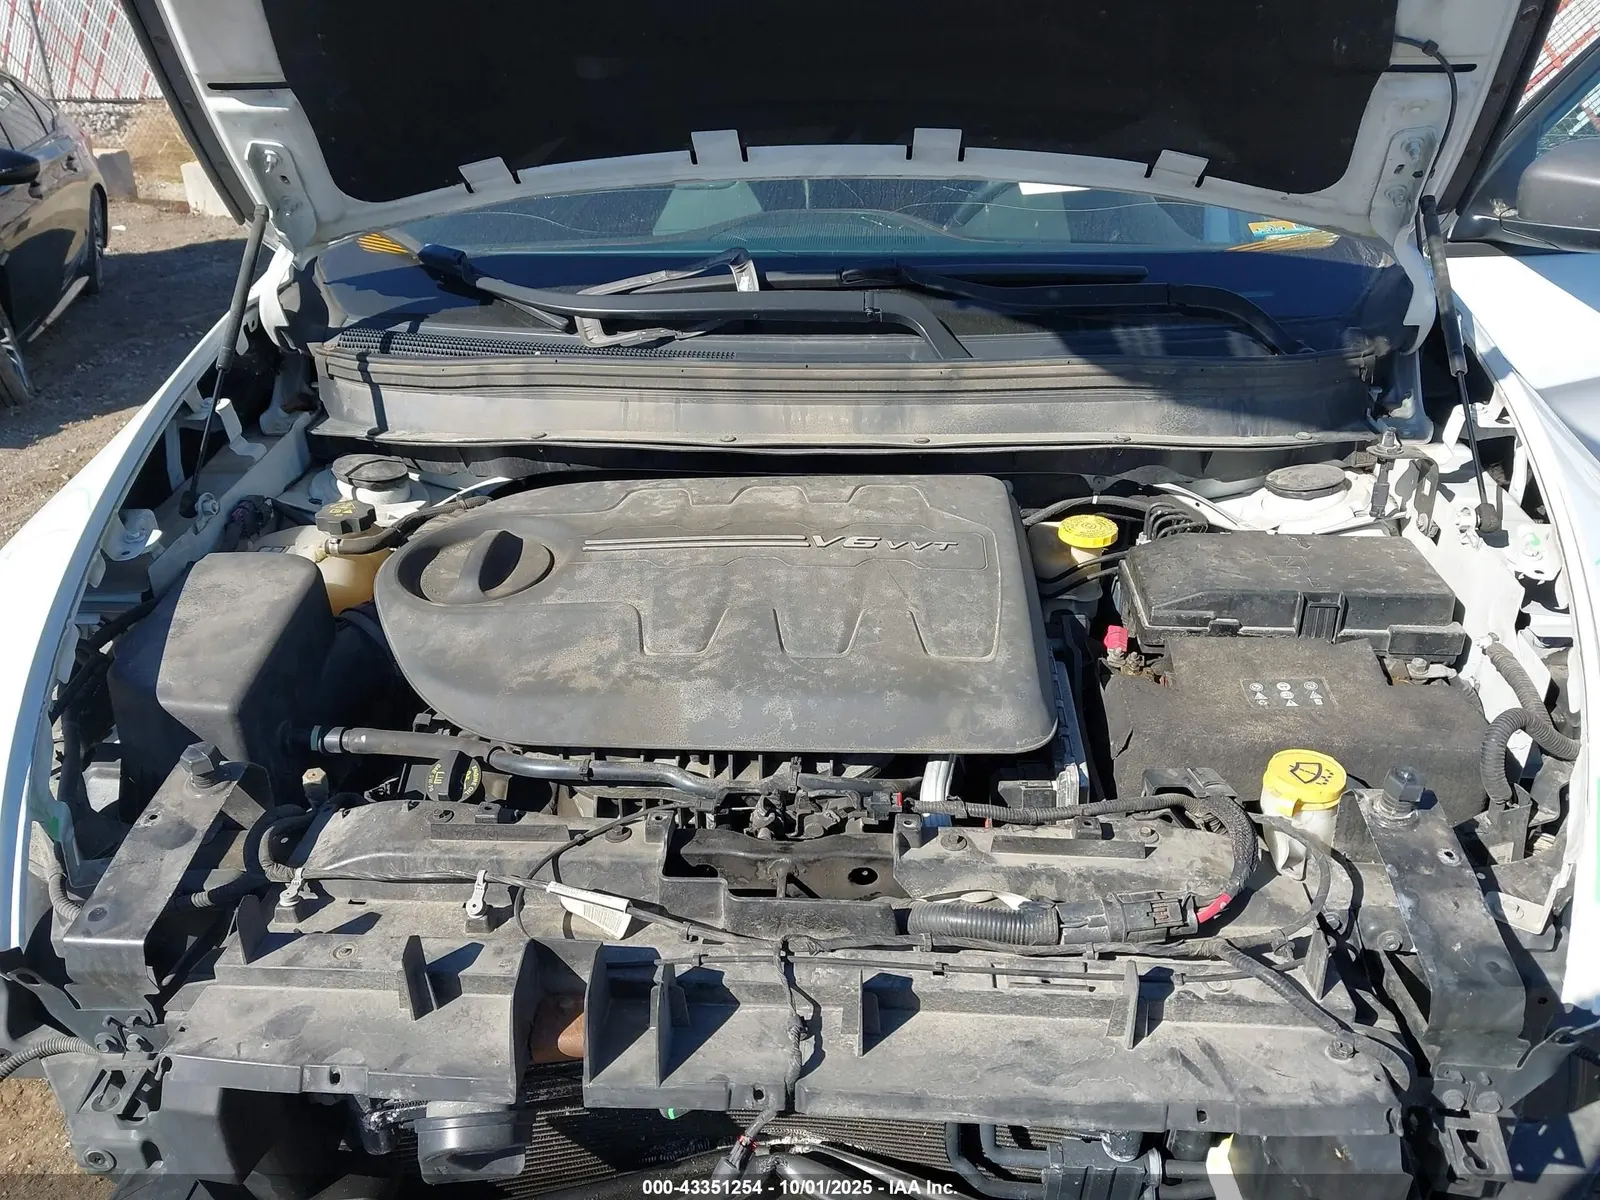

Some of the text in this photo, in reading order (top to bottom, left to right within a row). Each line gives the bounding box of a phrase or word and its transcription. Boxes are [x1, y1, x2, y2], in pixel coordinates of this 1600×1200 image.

[812, 535, 959, 551] V6 VVT
[464, 765, 479, 796] ENGINE OIL
